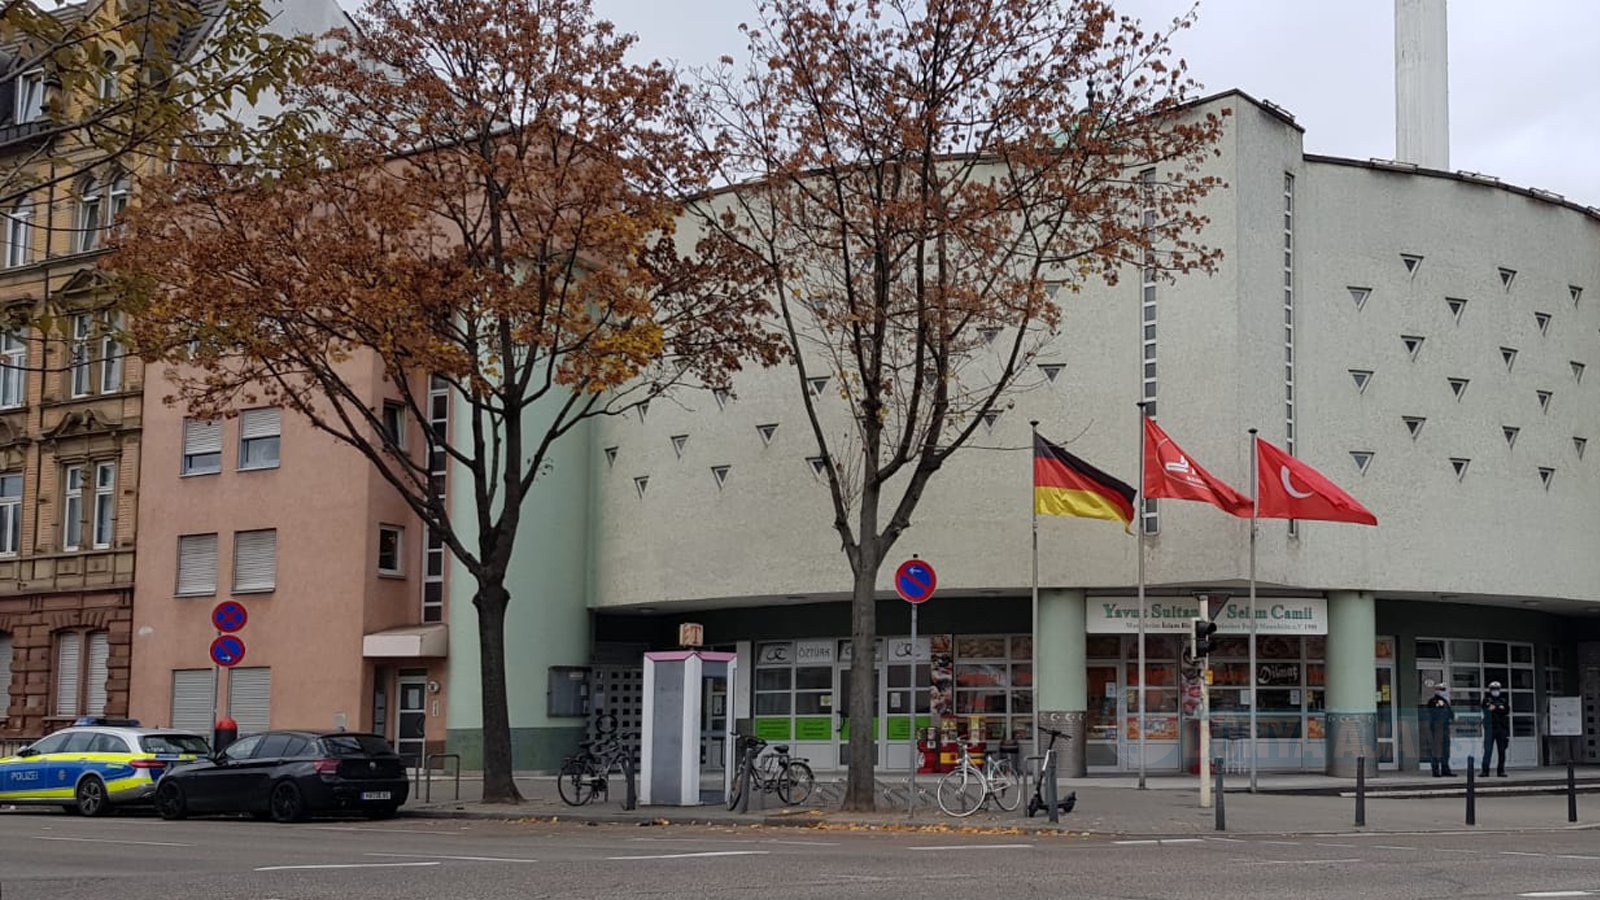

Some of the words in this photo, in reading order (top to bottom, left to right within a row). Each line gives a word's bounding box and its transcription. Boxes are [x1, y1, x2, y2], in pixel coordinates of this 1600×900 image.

[1227, 605, 1267, 619] Selm
[1271, 605, 1313, 620] Camii
[10, 771, 40, 781] POLIZEI
